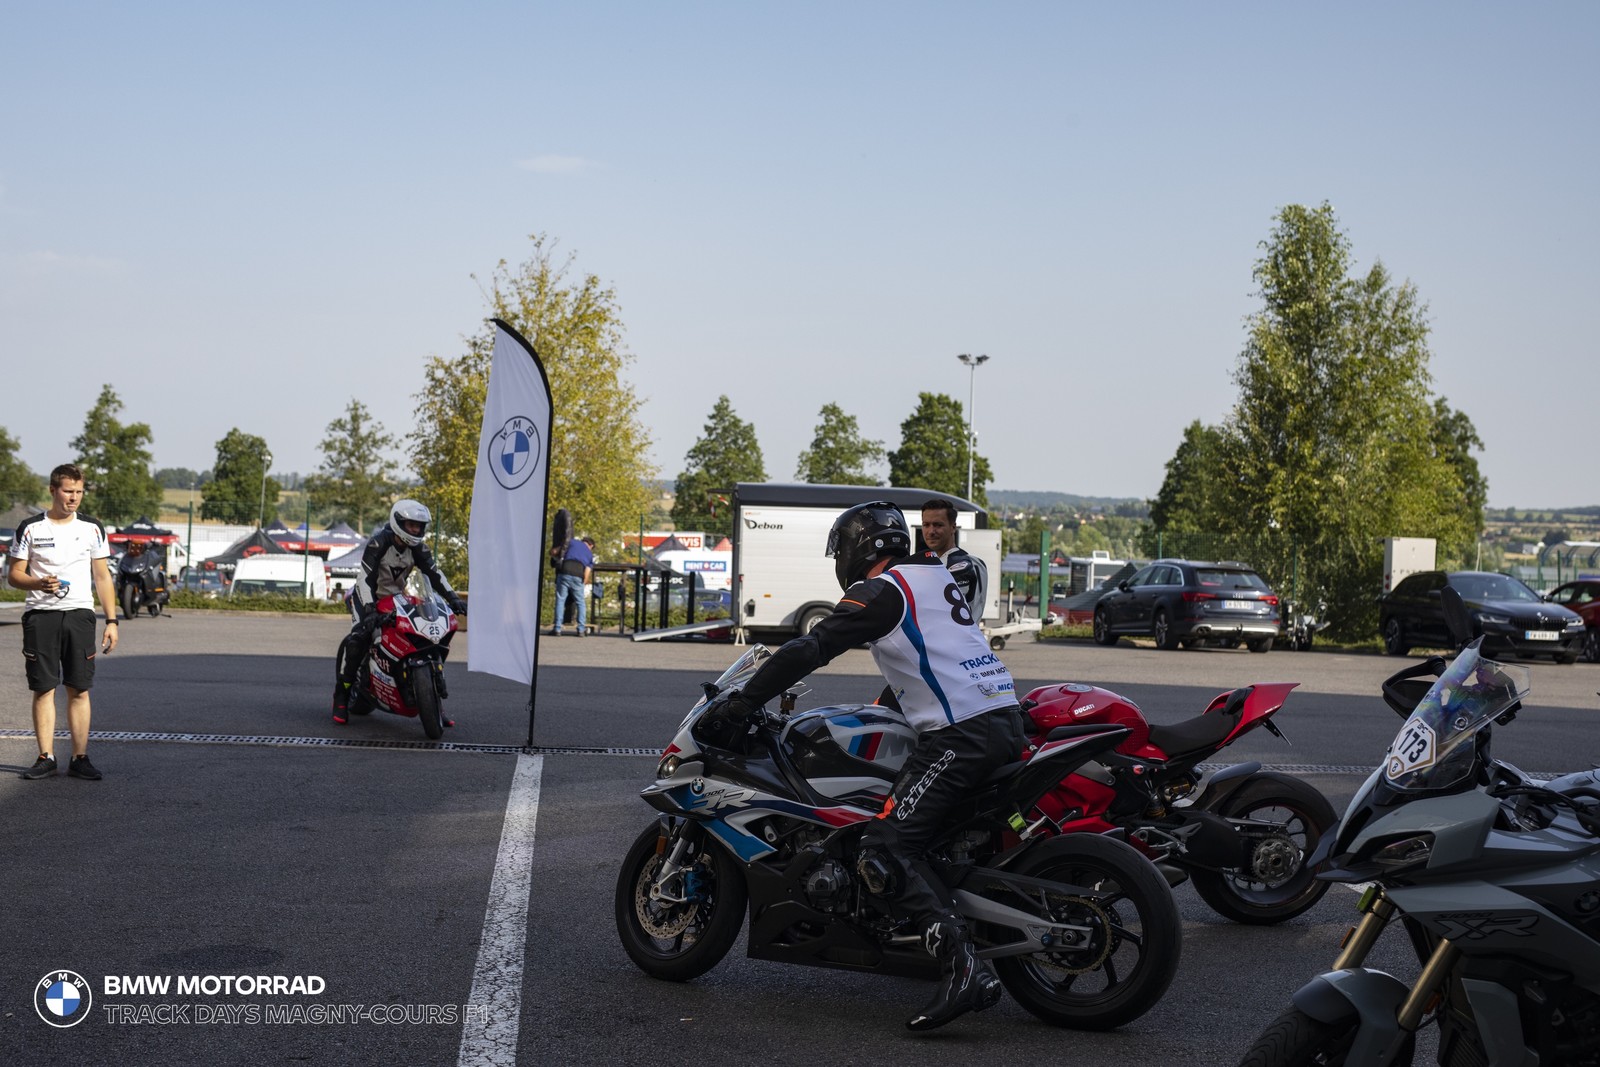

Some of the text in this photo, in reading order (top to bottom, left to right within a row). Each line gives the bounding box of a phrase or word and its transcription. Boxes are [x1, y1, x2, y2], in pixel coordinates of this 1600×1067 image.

[743, 517, 784, 530] Debon
[943, 583, 975, 626] 8
[428, 626, 440, 636] 25
[959, 653, 1000, 671] TRACK
[1073, 703, 1096, 716] DUCATI
[1397, 727, 1428, 764] 173
[896, 749, 956, 821] alpinestars
